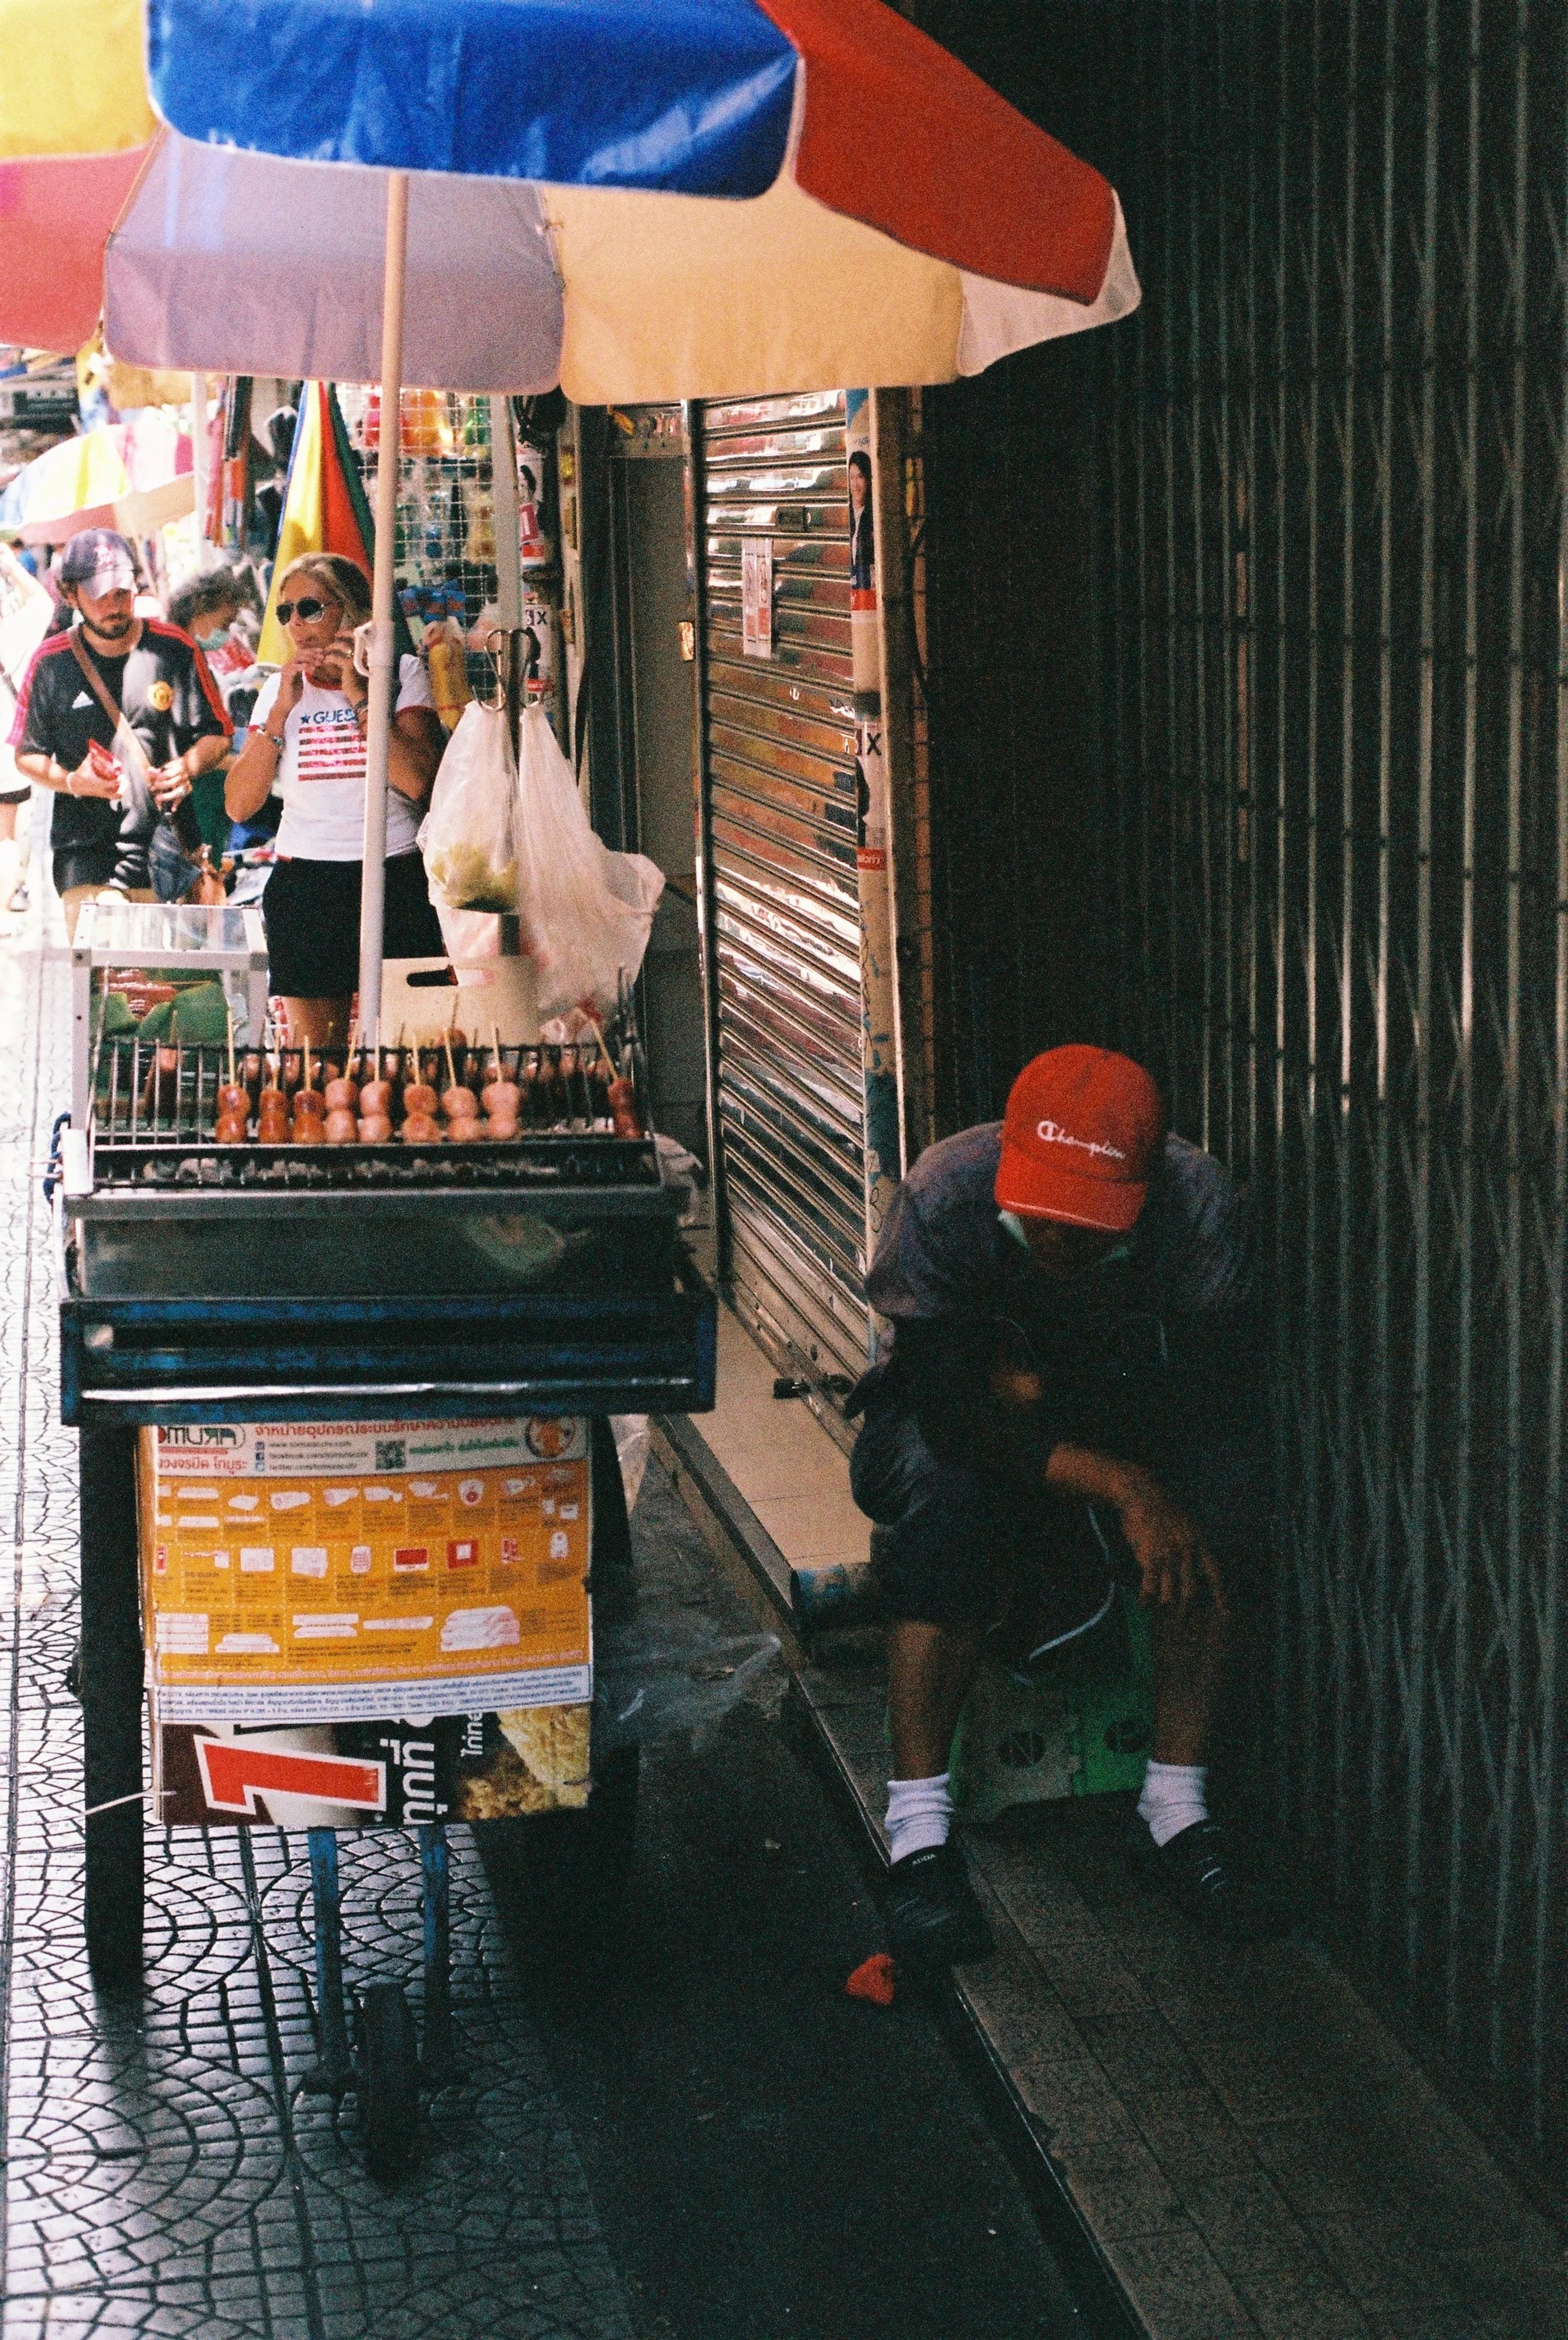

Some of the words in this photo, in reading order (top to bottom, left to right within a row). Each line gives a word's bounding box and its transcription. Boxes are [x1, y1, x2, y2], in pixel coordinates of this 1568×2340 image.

[312, 708, 356, 724] GUES
[1036, 1119, 1126, 1159] Champion
[193, 1733, 387, 1816] 1
